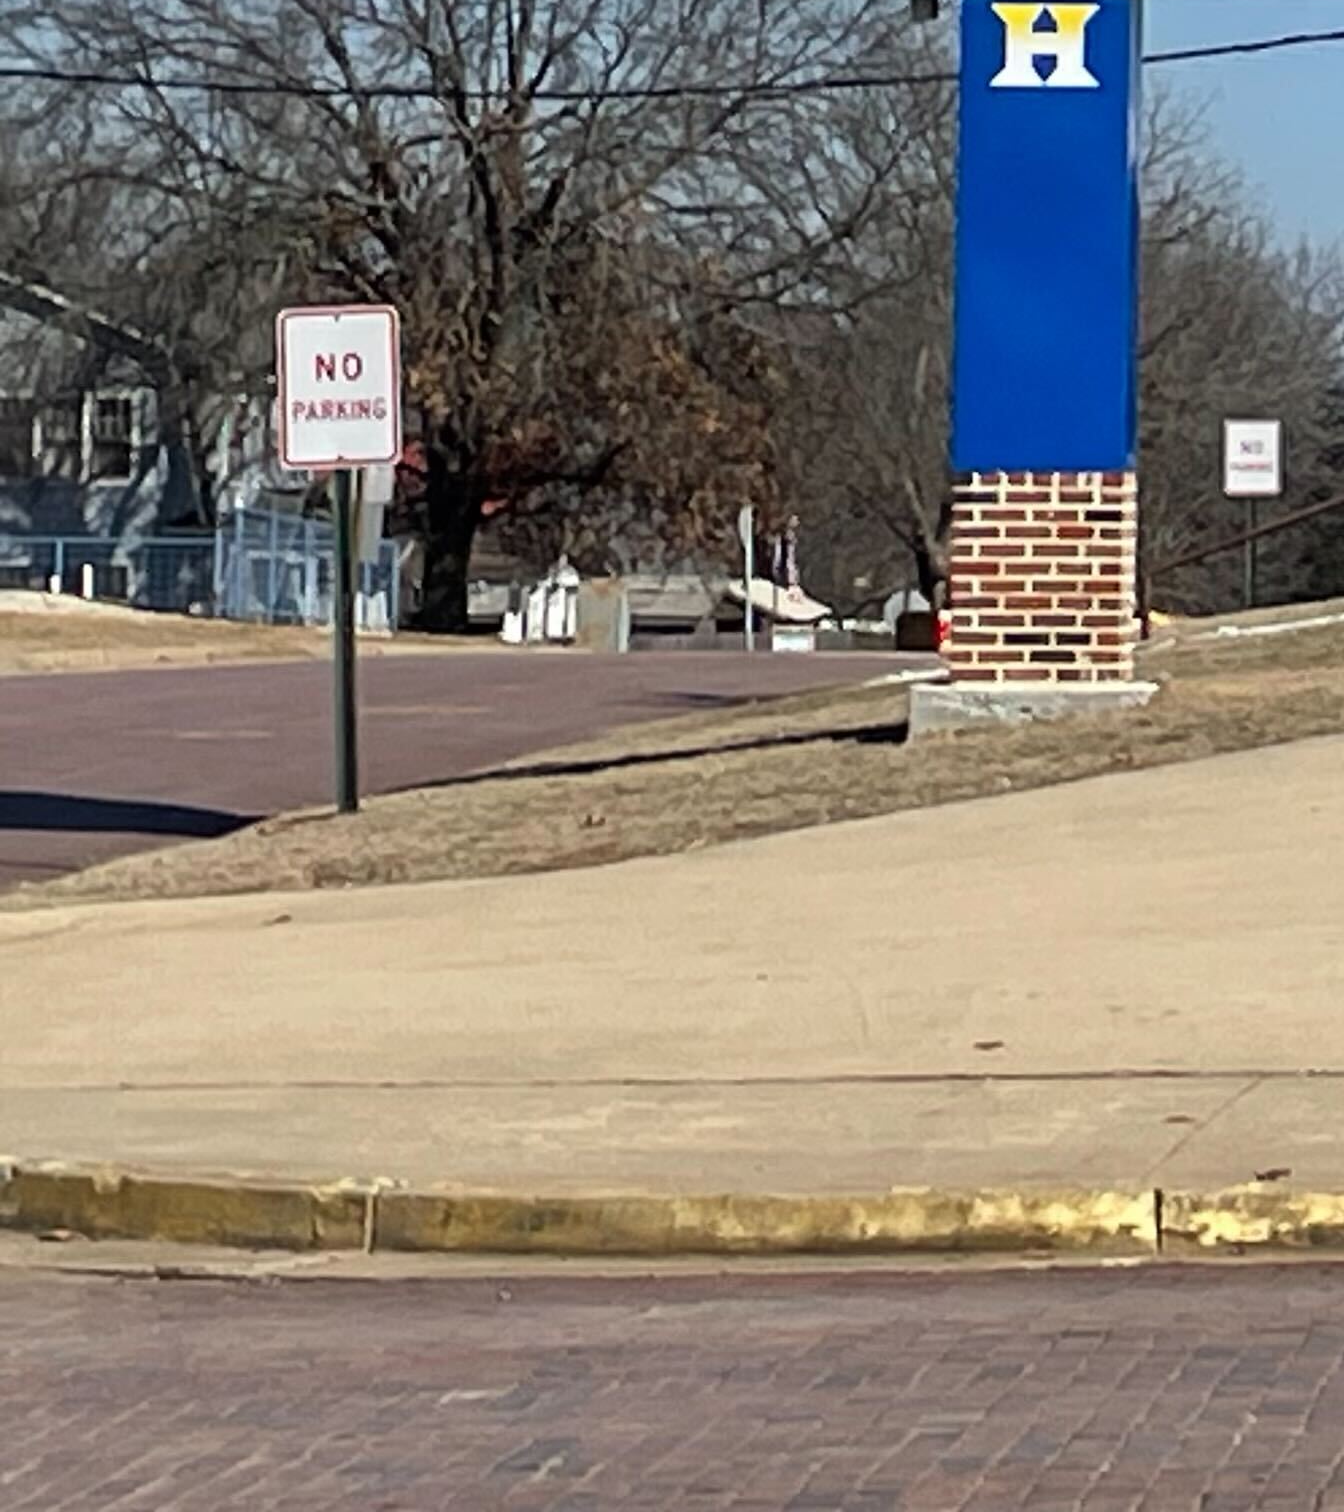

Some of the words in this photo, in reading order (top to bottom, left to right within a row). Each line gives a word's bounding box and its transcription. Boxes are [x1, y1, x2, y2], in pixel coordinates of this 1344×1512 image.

[988, 1, 1101, 88] H
[315, 352, 363, 382] NO
[291, 396, 387, 423] PARKING
